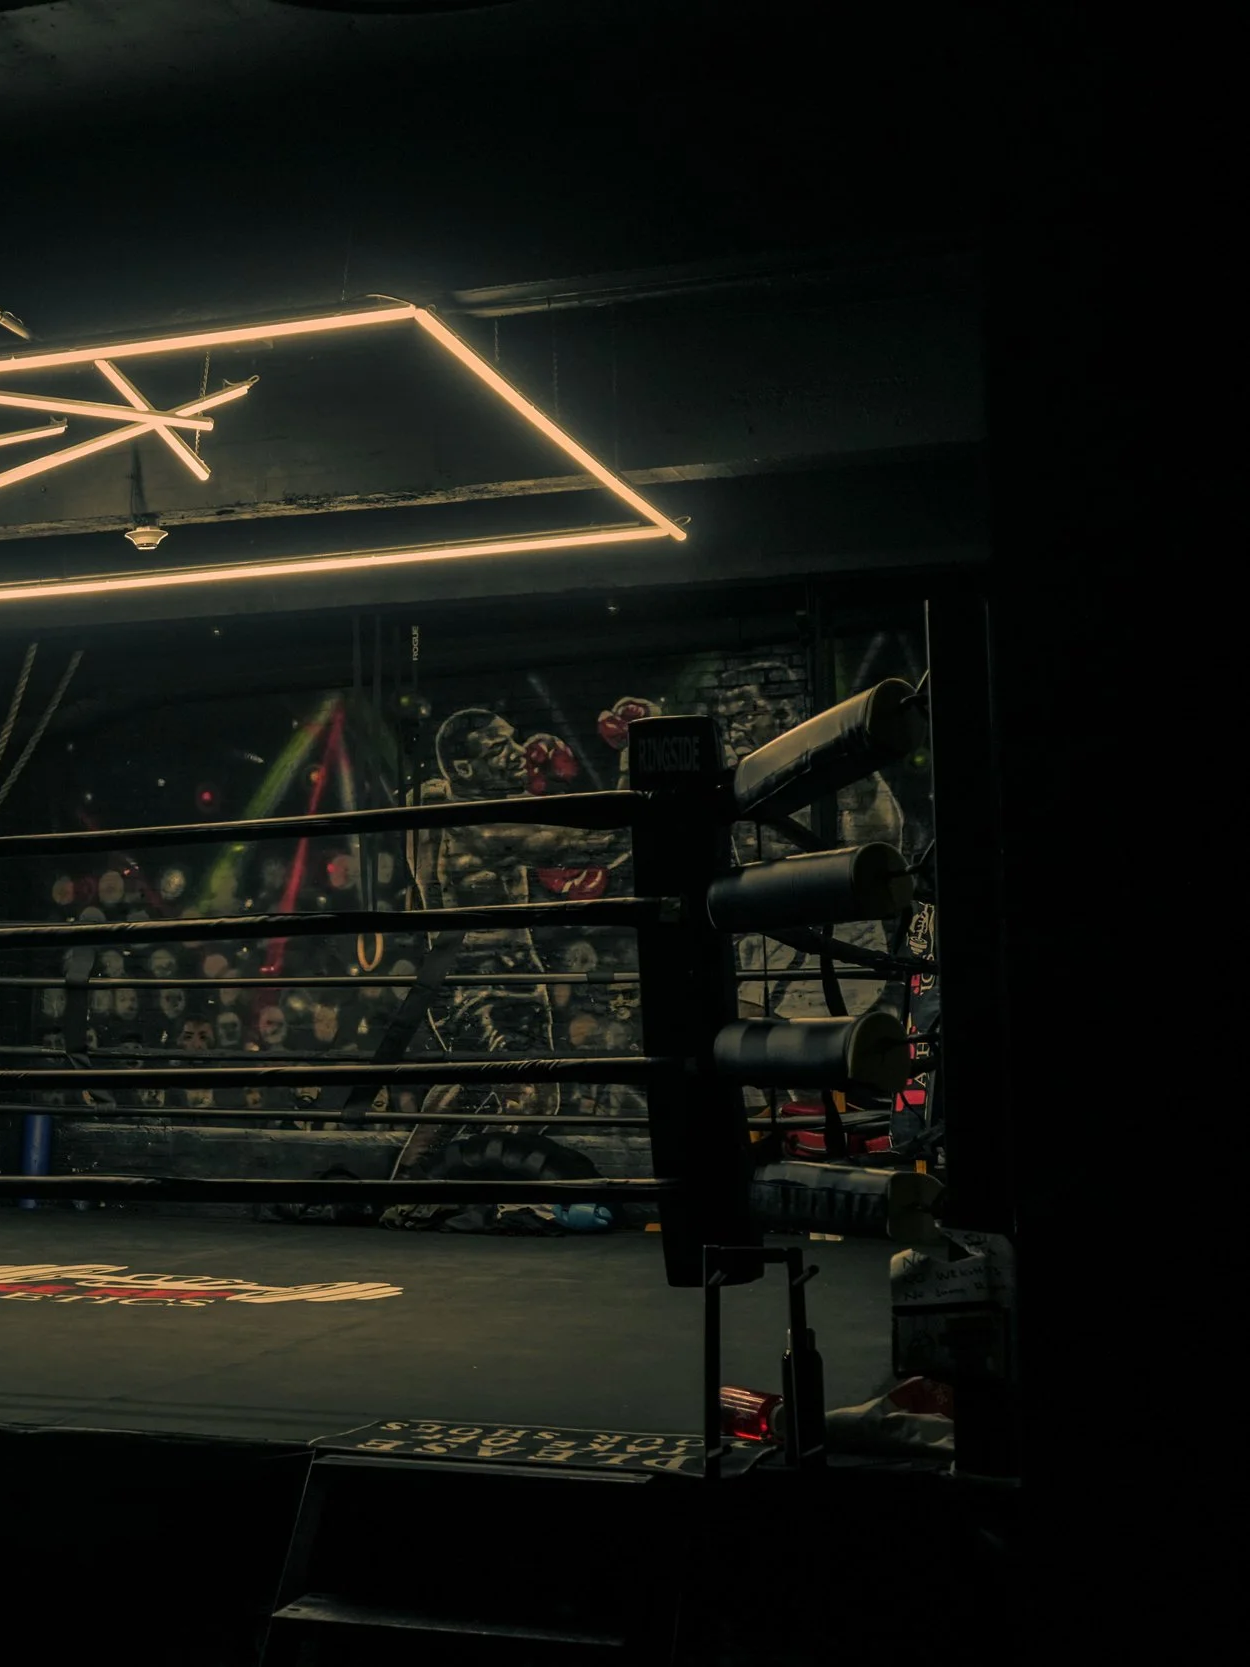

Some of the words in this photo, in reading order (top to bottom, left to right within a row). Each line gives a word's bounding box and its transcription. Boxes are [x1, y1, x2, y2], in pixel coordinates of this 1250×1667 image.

[638, 736, 701, 773] RINGSIDE
[379, 1421, 562, 1440] SHOES
[411, 1433, 519, 1446] OFF
[357, 1438, 697, 1471] PLEASE
[543, 1440, 687, 1455] TAKE
